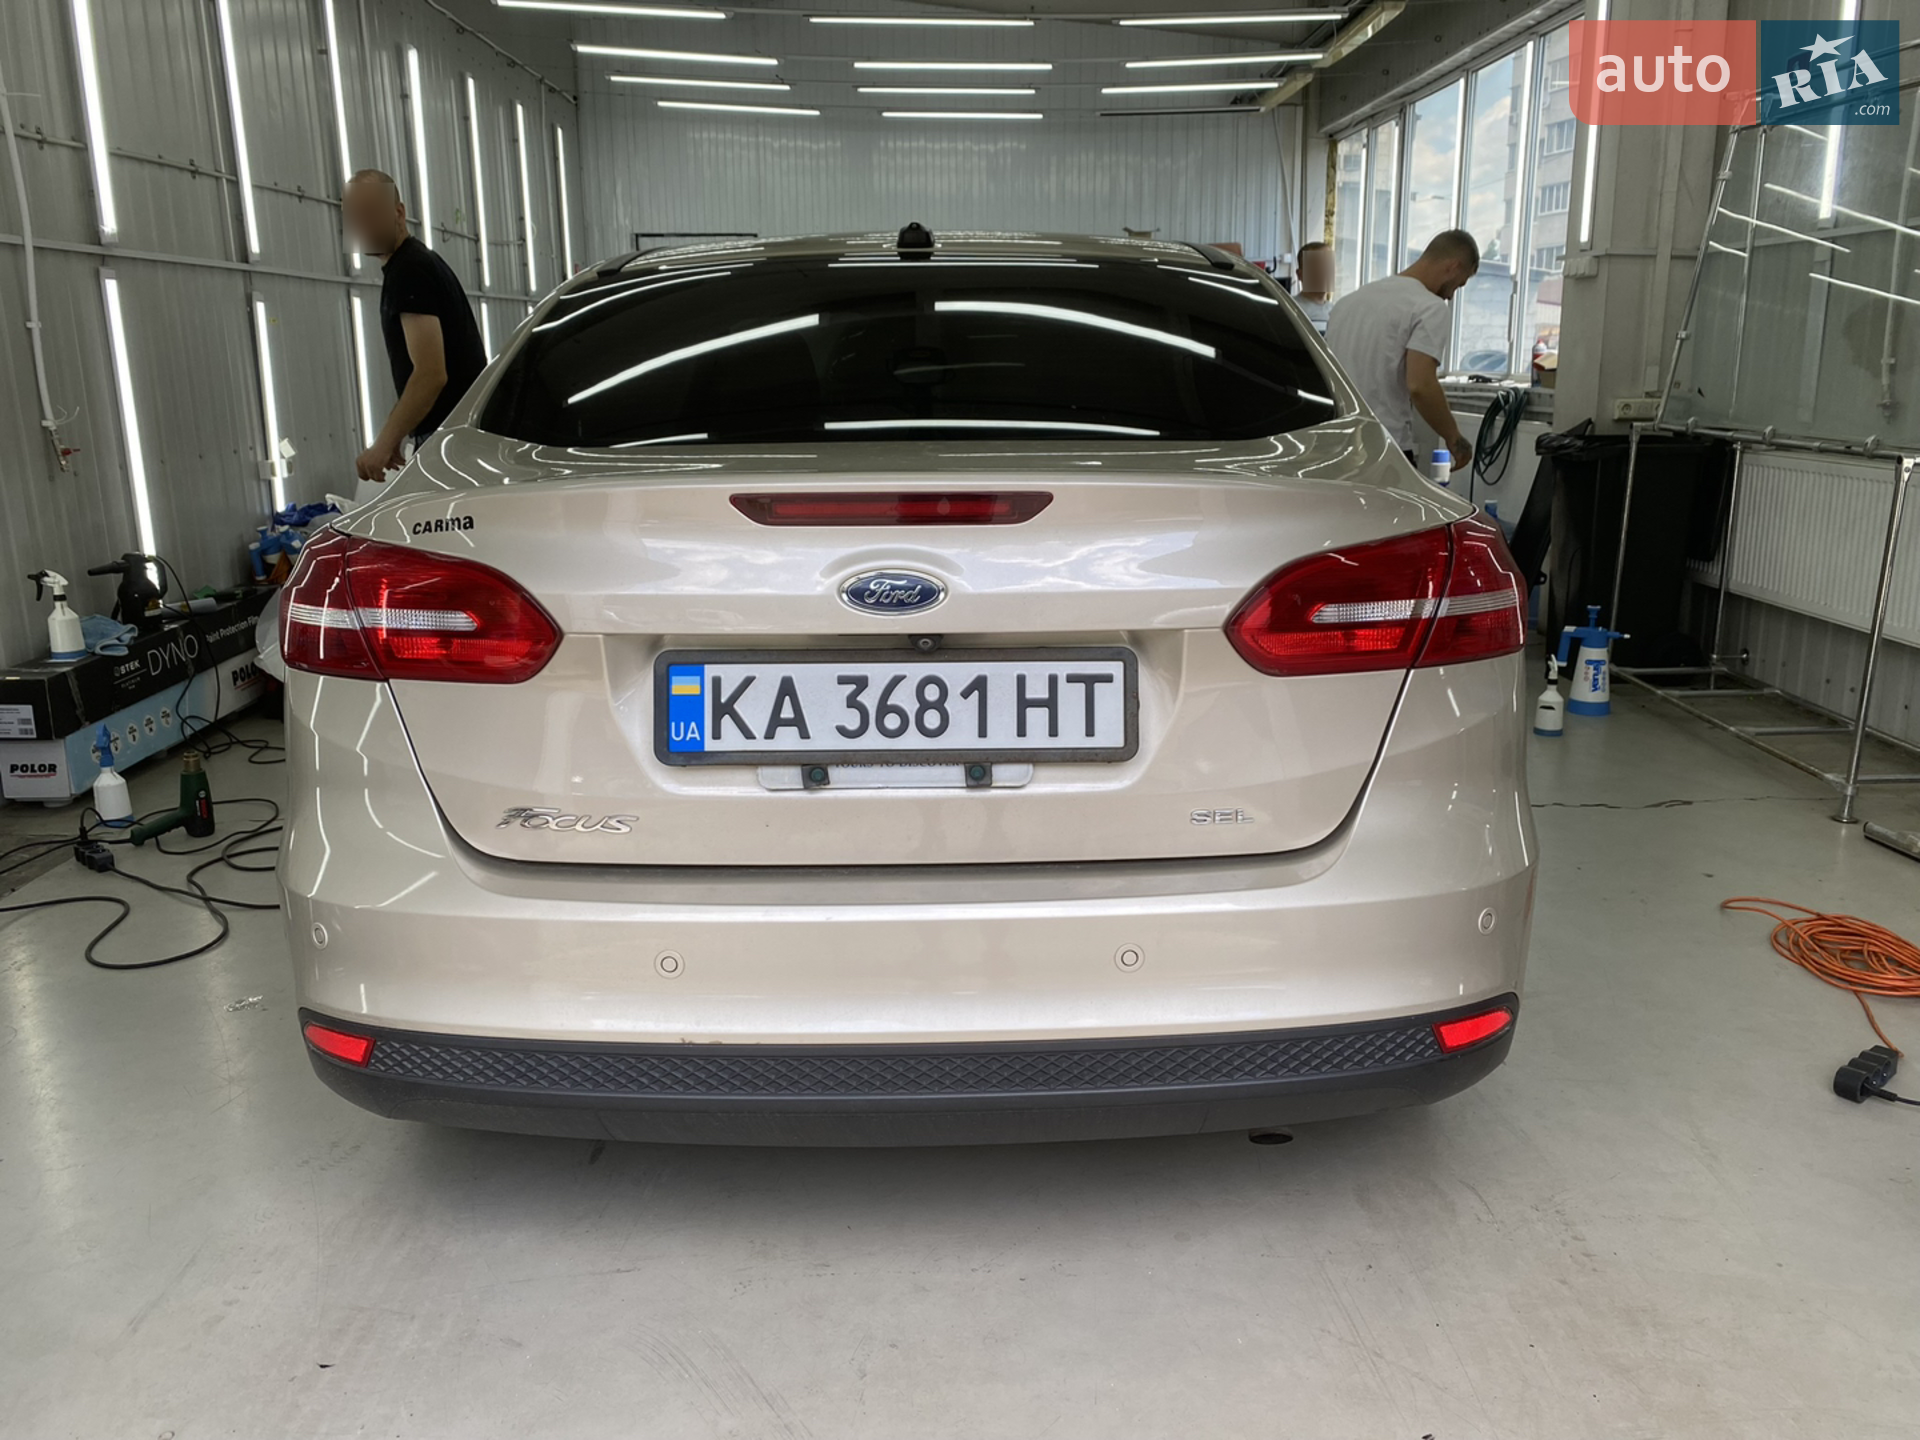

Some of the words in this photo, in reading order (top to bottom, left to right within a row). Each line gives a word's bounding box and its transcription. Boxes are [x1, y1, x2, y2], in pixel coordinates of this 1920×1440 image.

[863, 578, 923, 604] Ford
[147, 634, 199, 676] DYNO
[231, 660, 258, 687] POLO
[711, 675, 812, 741] KA
[834, 674, 989, 740] 3681
[1016, 673, 1114, 738] HT
[671, 721, 701, 742] UA
[9, 763, 58, 774] POLOR
[1189, 808, 1255, 825] SEL
